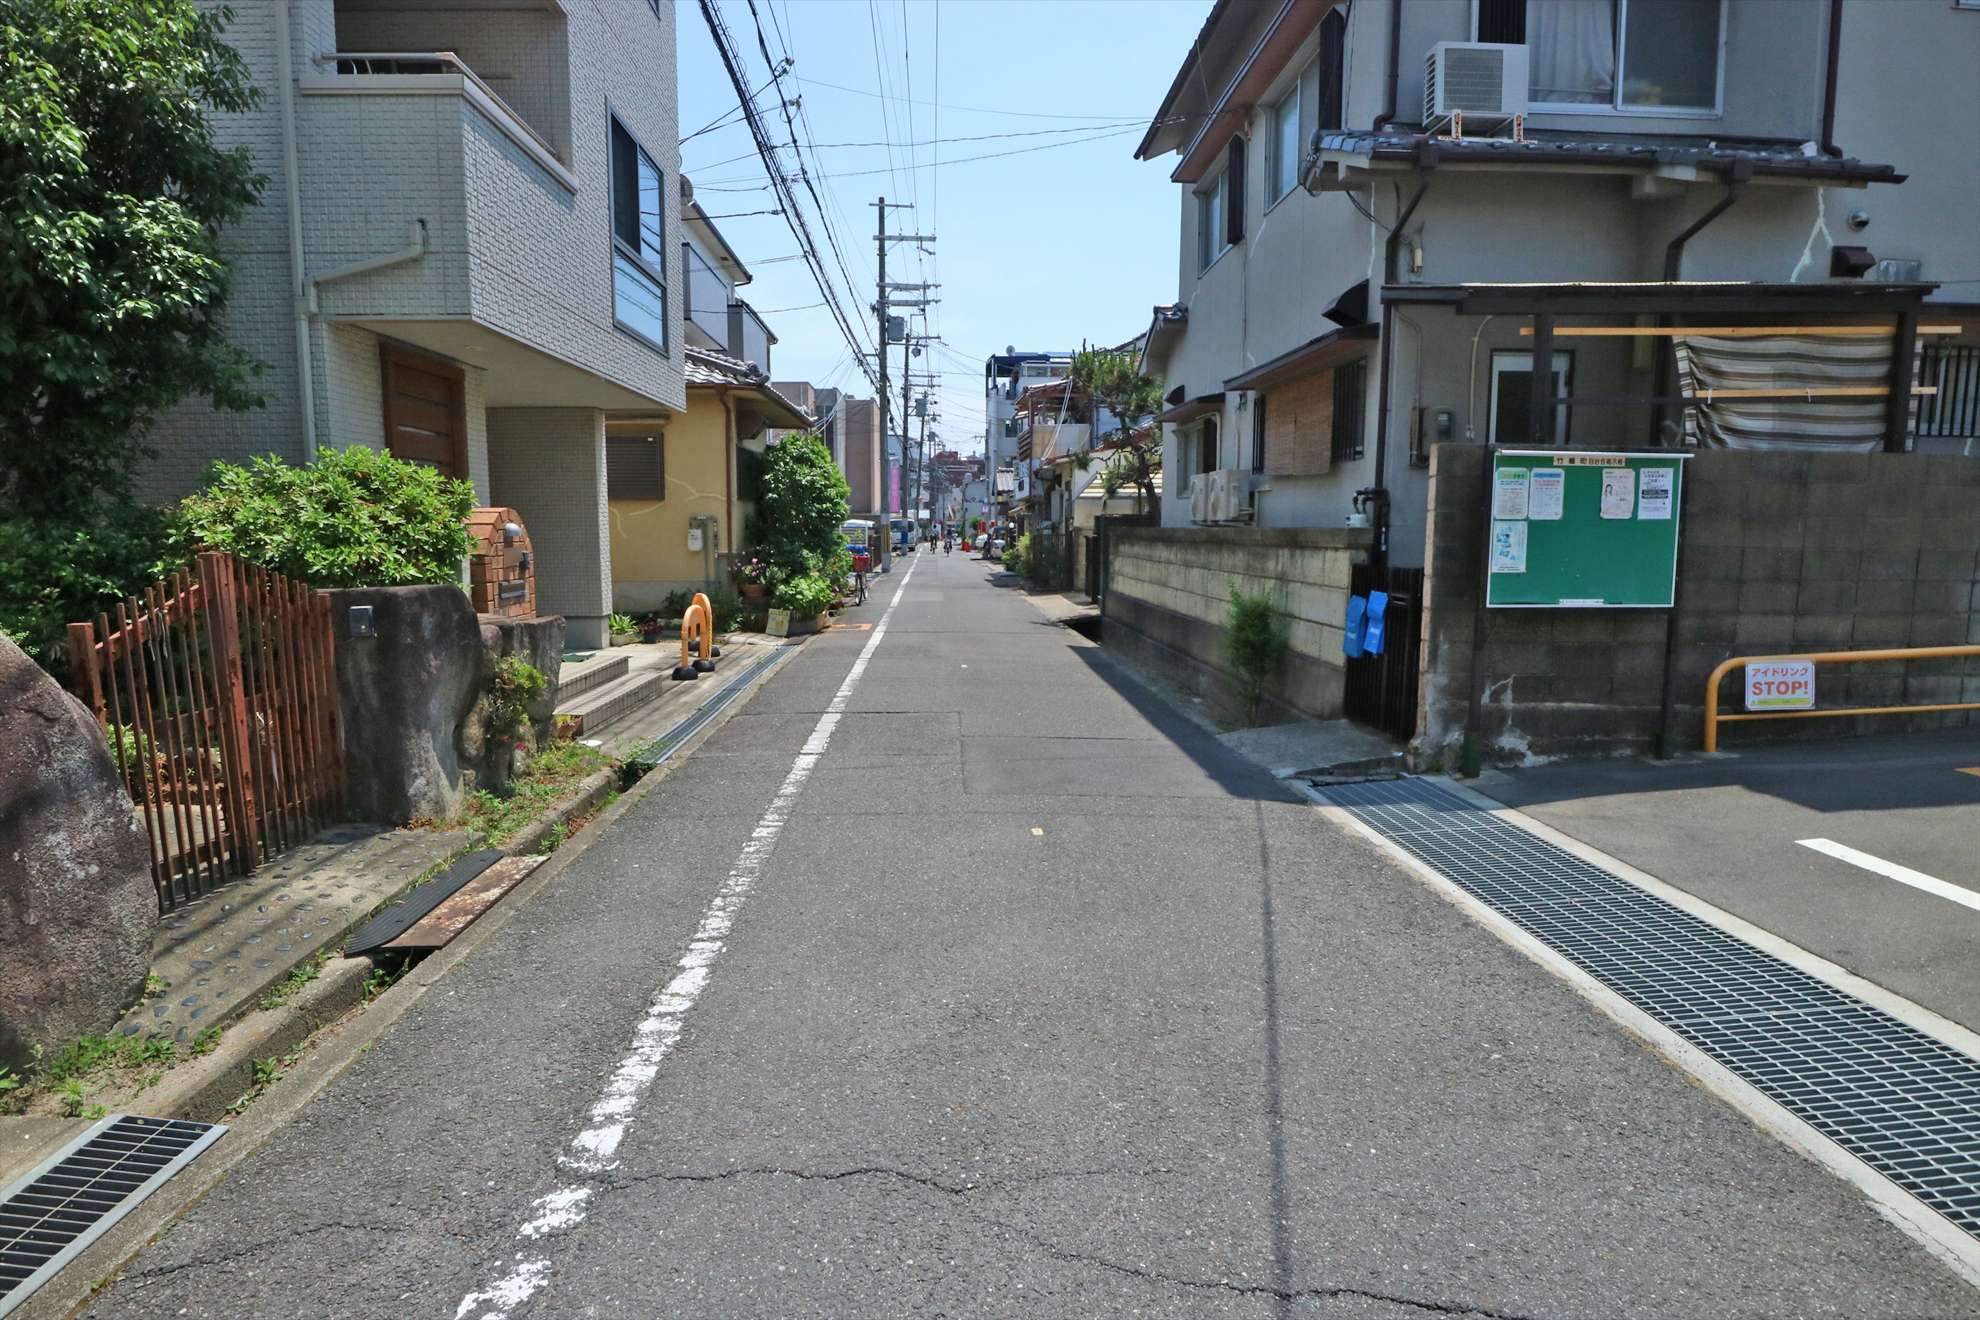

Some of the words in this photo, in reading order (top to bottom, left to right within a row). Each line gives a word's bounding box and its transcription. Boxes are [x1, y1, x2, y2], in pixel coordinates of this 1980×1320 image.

[1752, 667, 1808, 677] アイドリング
[1752, 681, 1808, 696] STOP!
